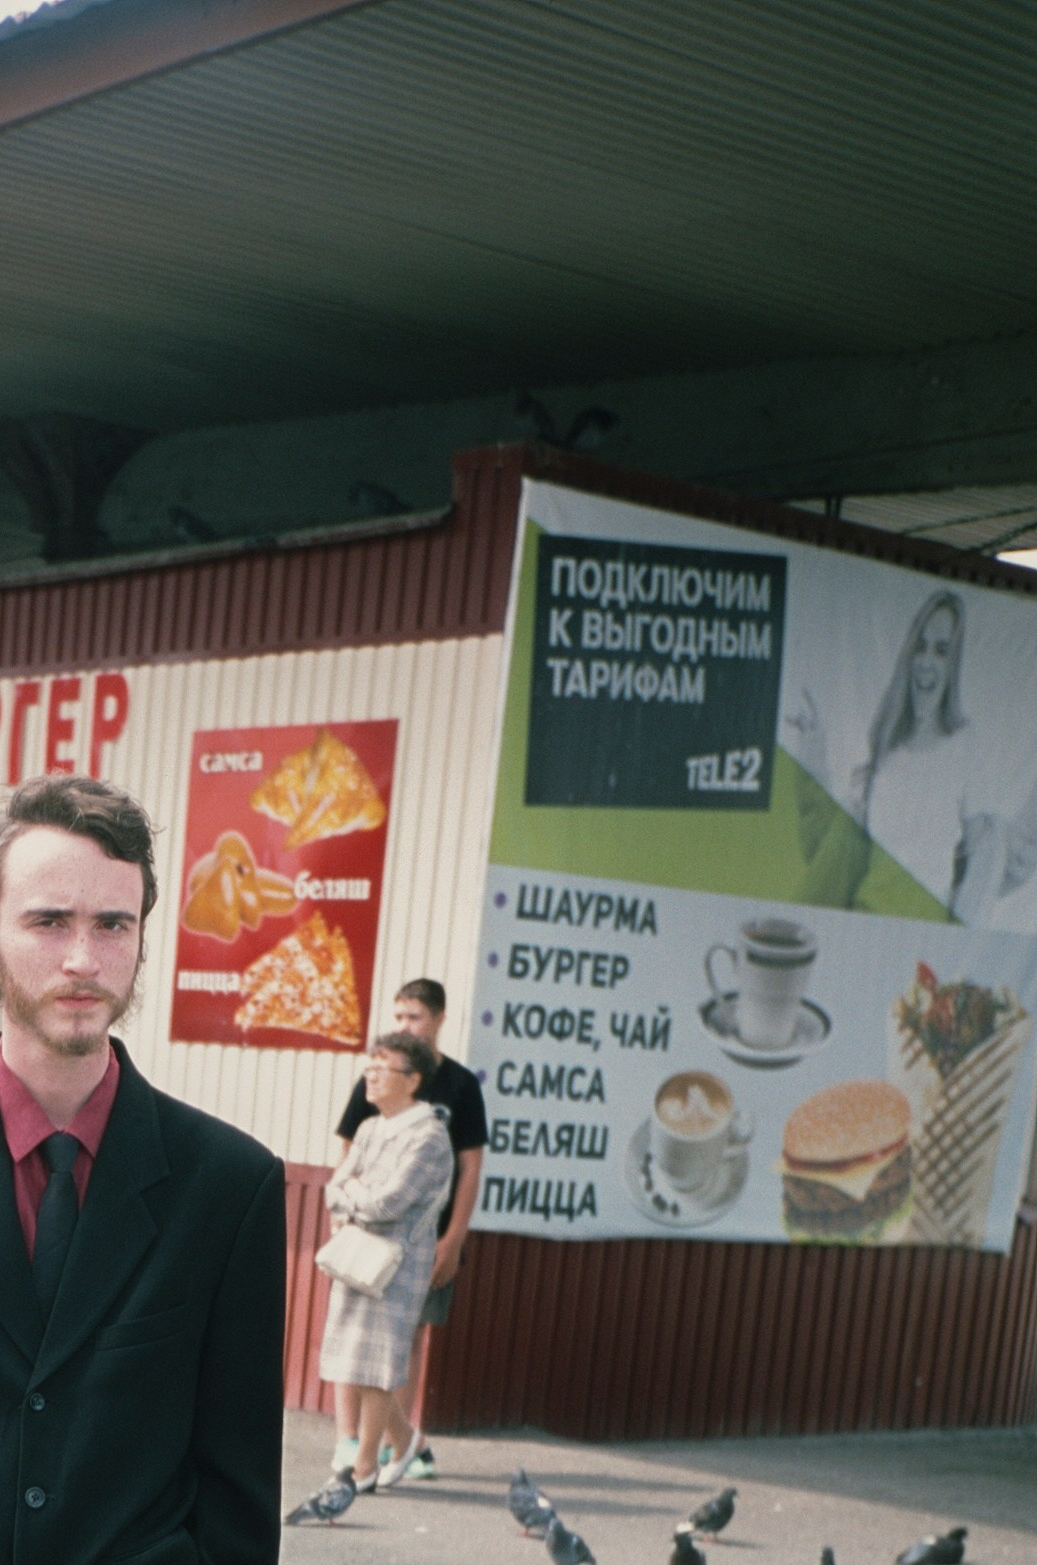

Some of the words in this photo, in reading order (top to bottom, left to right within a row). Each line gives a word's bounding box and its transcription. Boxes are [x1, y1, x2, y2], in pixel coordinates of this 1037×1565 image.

[551, 557, 771, 612] ПОДКЛЮЧИМ
[548, 607, 573, 648] К
[581, 609, 772, 663] ВЫГОДНЫМ
[546, 656, 706, 704] ТАРИФАМ
[686, 748, 762, 792] TELE2
[294, 869, 371, 900] беляш
[516, 884, 658, 936] ШАУРМА
[507, 944, 630, 990] БУРГЕР
[501, 1001, 601, 1051] КОФЕ,
[610, 1005, 672, 1051] ЧАЙ
[495, 1060, 606, 1103] САМСА
[488, 1118, 609, 1160] БЕЛЯШ
[480, 1176, 598, 1222] ПИЦЦА
